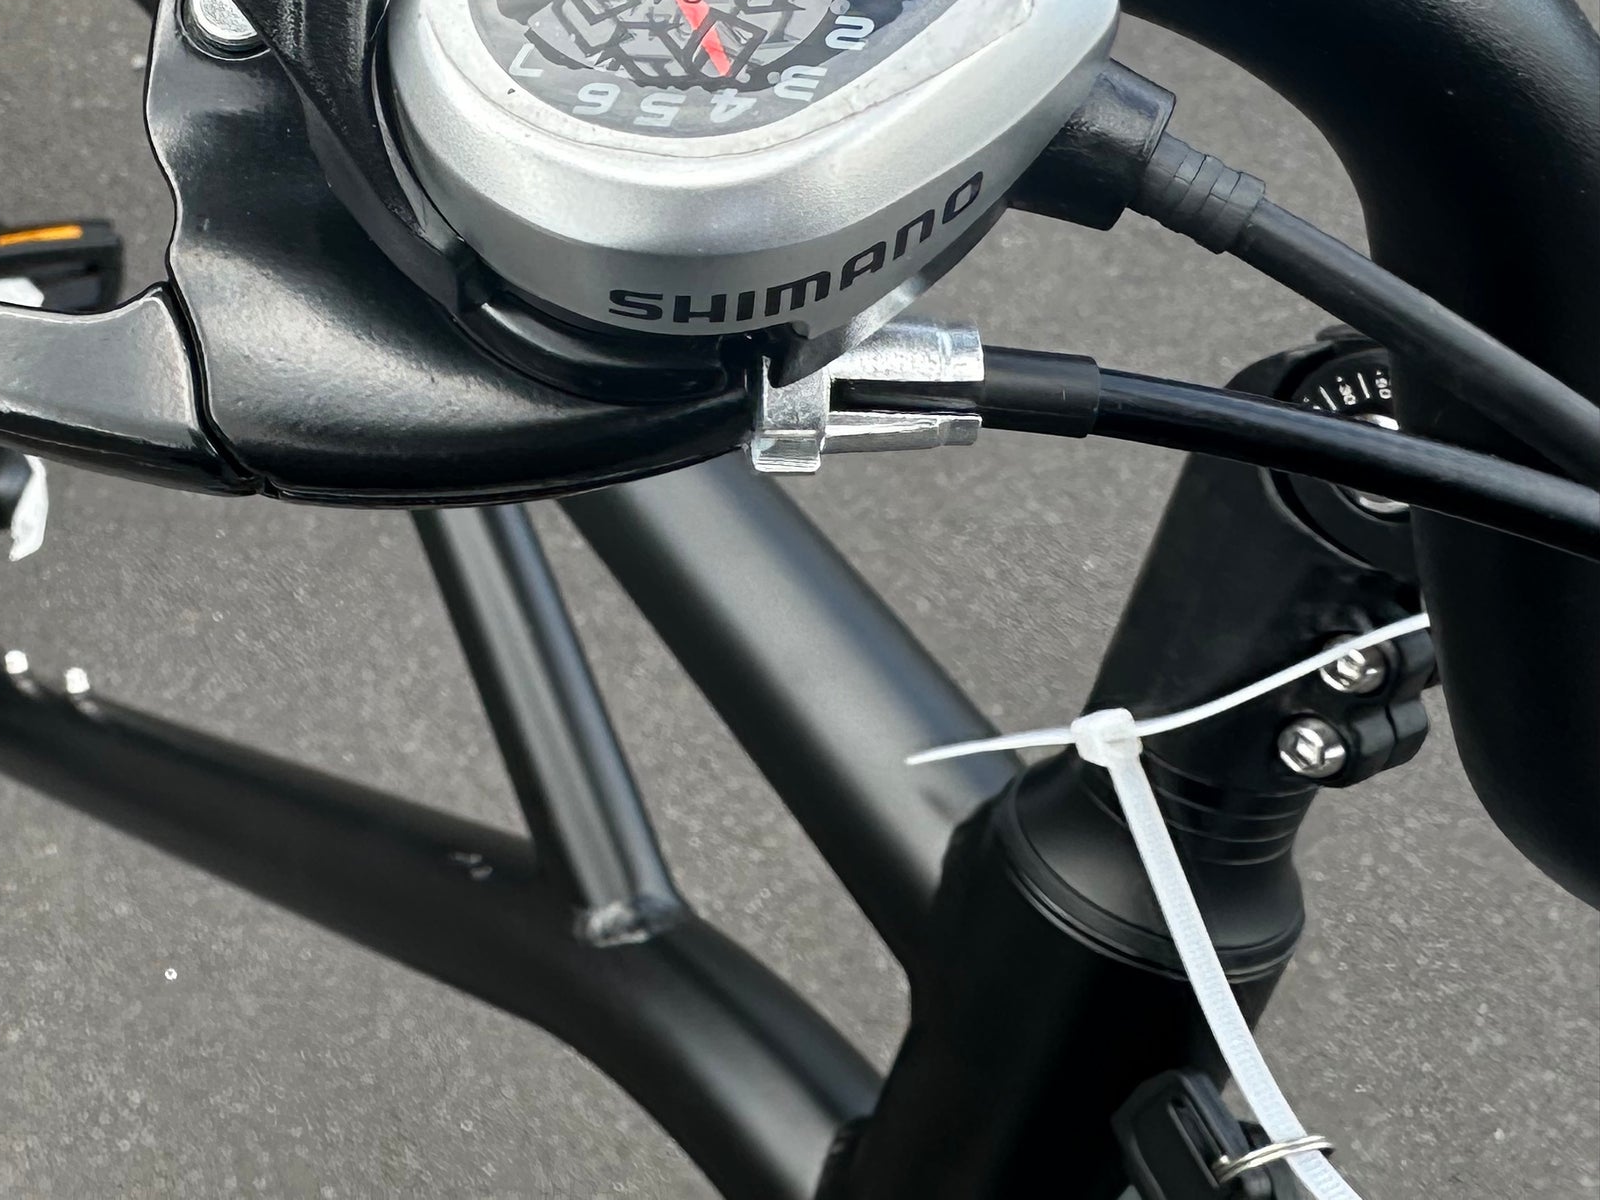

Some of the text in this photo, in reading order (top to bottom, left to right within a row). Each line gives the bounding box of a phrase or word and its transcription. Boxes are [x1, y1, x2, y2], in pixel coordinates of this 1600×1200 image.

[825, 16, 875, 51] 2
[510, 44, 544, 79] 7
[577, 82, 621, 115] 6
[776, 65, 827, 100] 3
[636, 94, 687, 127] 5
[712, 88, 757, 124] 4
[608, 171, 984, 323] SHIMANO
